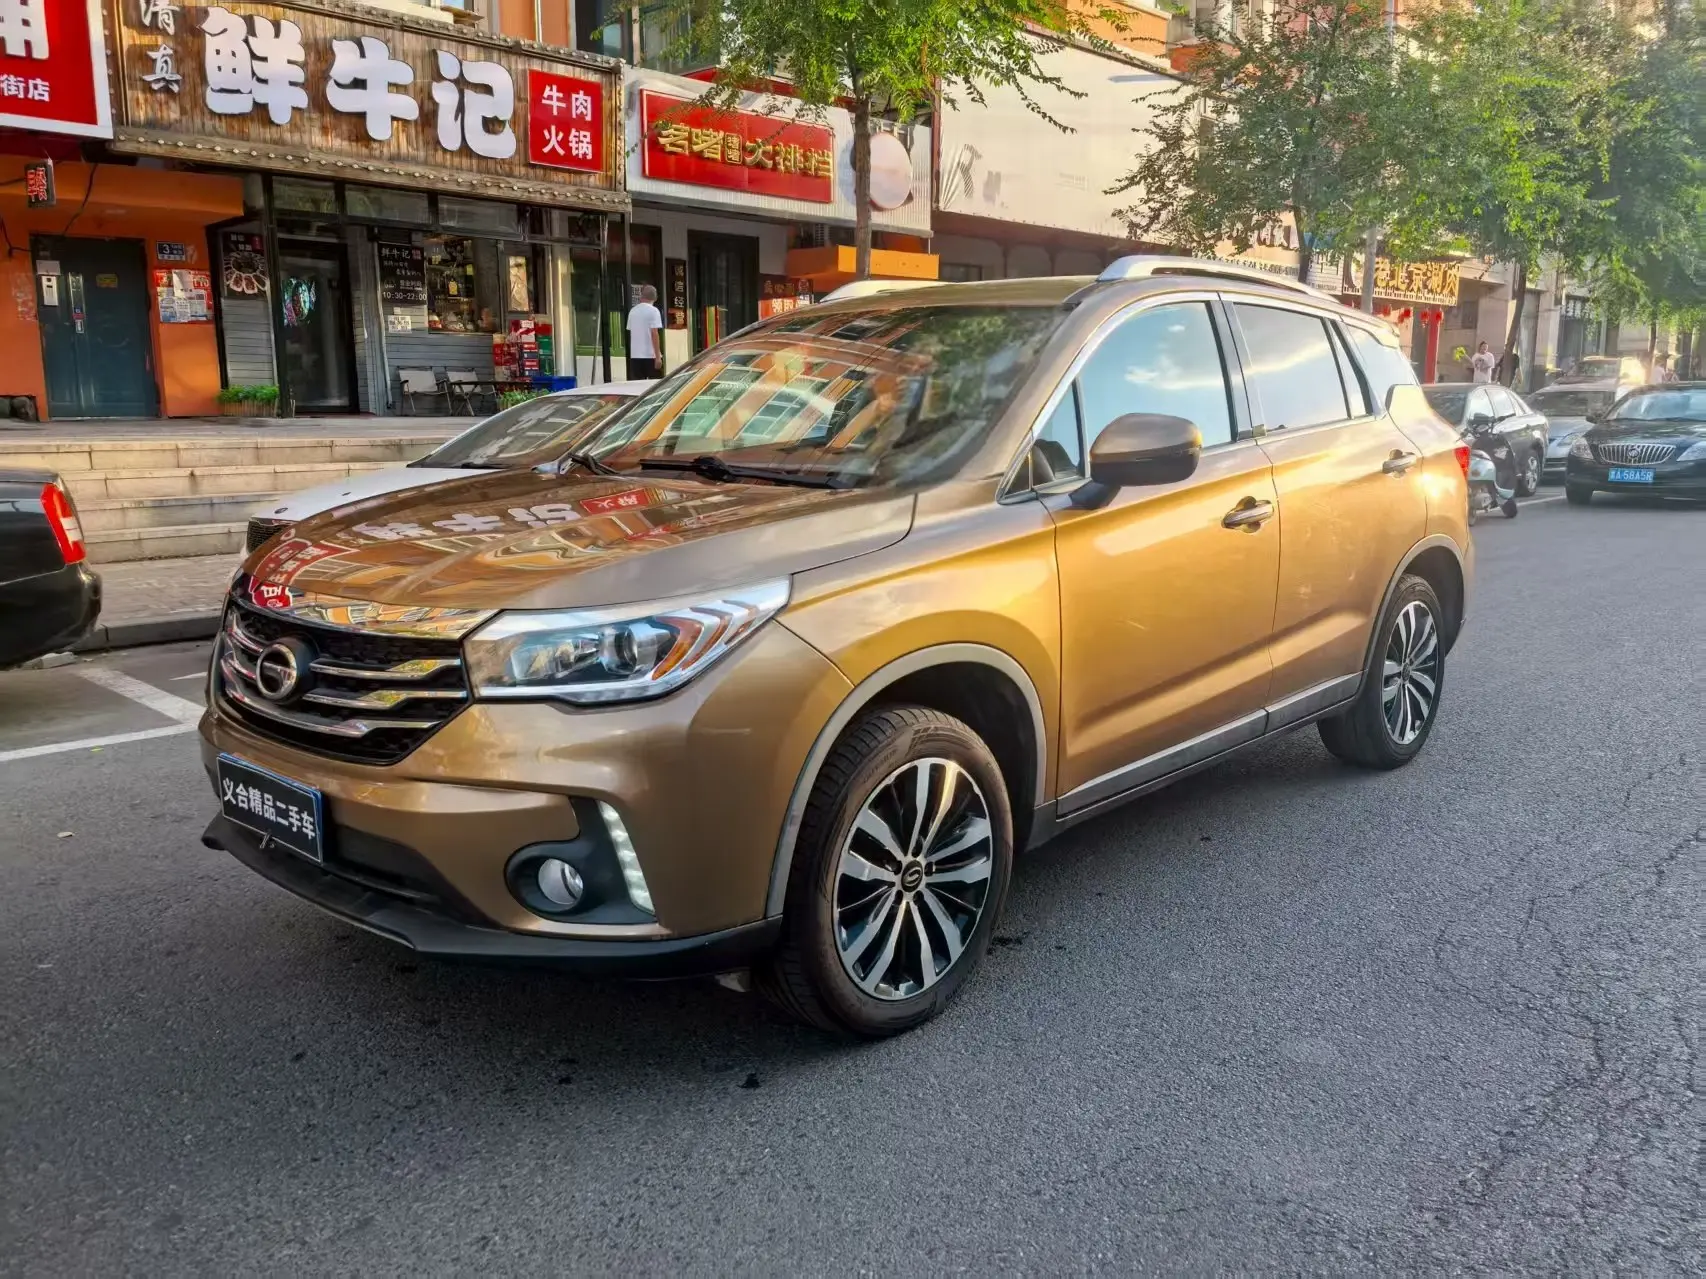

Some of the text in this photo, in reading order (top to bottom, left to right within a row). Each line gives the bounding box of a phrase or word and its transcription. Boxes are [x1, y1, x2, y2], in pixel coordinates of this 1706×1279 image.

[140, 0, 182, 93] 清真
[0, 73, 50, 102] 街店
[198, 6, 517, 159] 鲜牛记
[541, 84, 592, 122] 牛肉
[541, 127, 593, 160] 火锅
[163, 244, 170, 254] 3
[222, 778, 316, 840] 义合精品二手车
